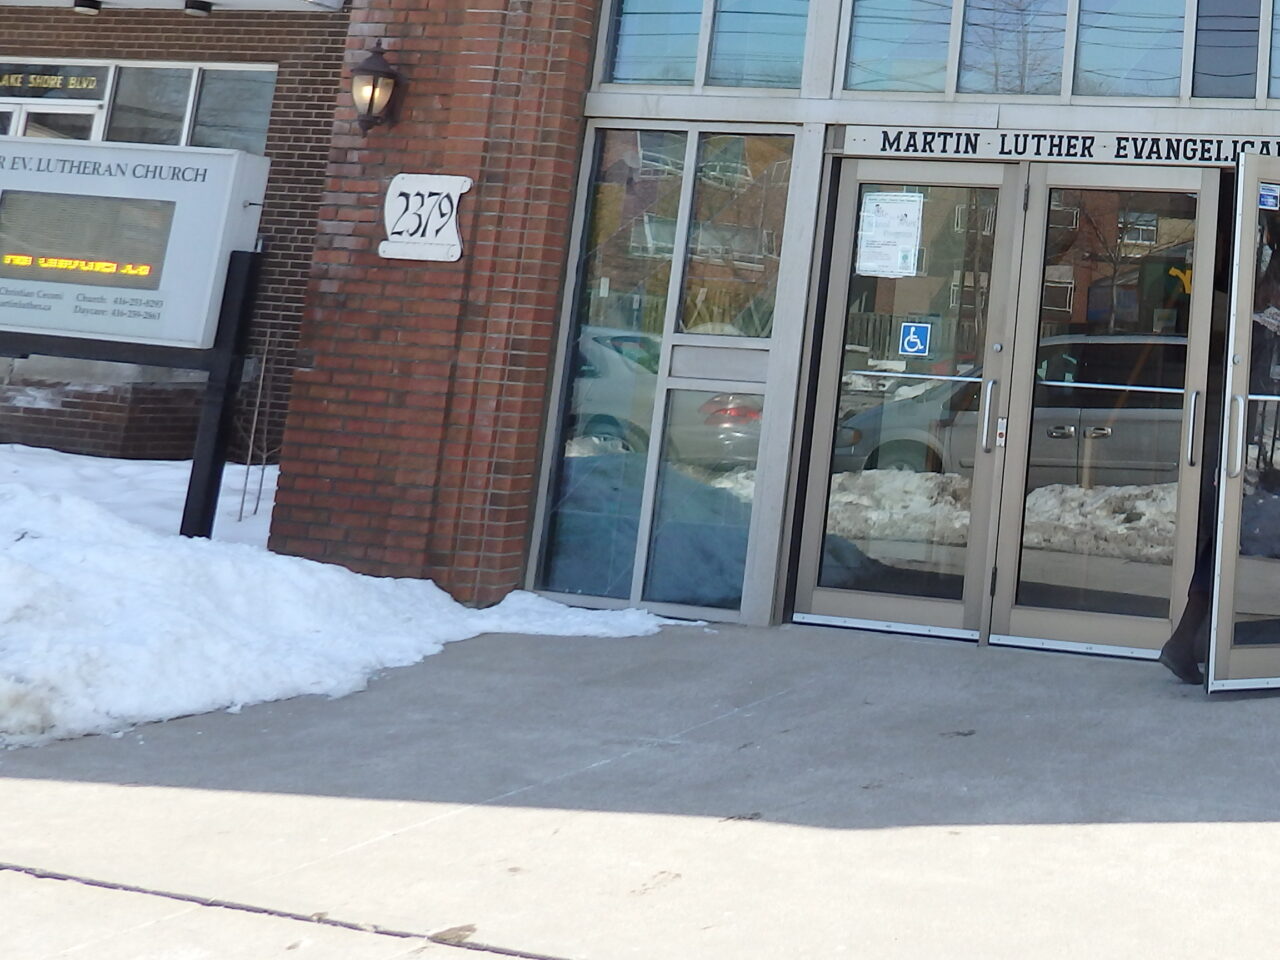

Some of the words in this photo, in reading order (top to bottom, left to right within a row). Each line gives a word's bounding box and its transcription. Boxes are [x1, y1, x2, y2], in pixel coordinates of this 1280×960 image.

[28, 75, 64, 88] SHORE
[880, 130, 981, 154] MARTIN
[998, 133, 1096, 158] LUTHER
[10, 156, 33, 171] EV.
[36, 157, 128, 177] LUTHERAN
[132, 163, 208, 183] CHURCH
[391, 191, 454, 238] 2379
